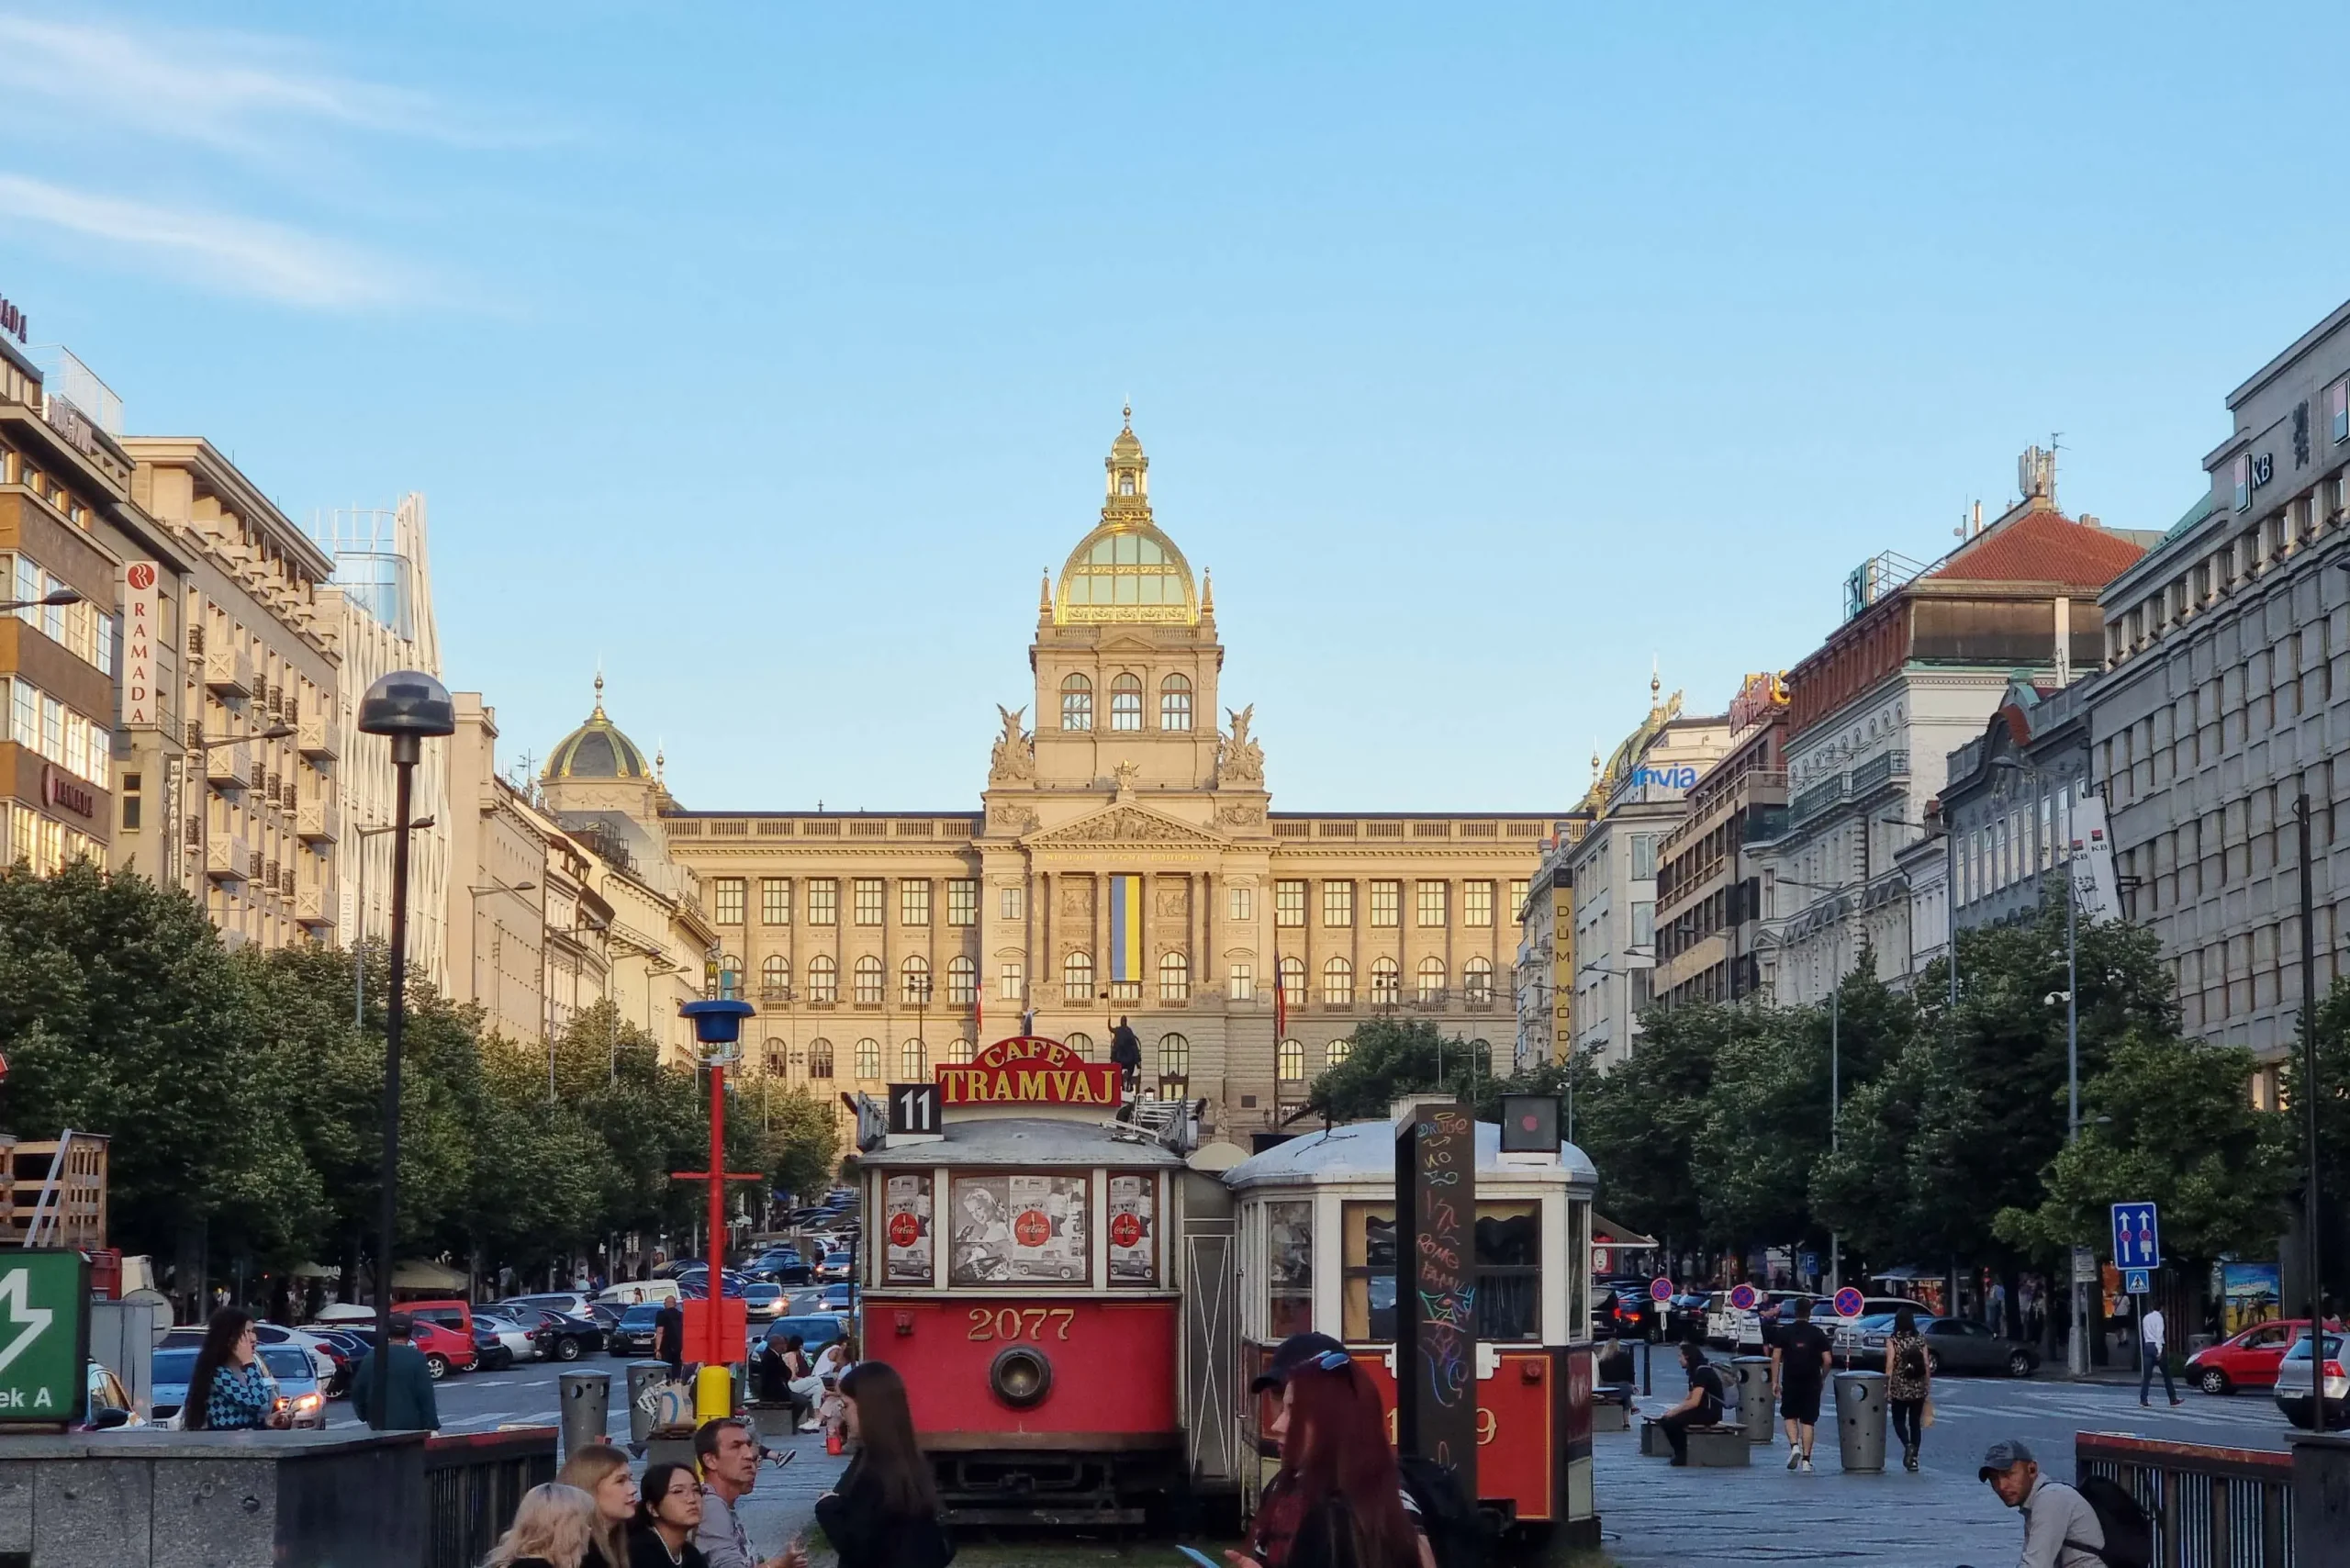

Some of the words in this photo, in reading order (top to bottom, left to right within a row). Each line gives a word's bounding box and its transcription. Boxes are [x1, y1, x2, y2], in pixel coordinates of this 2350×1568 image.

[0, 293, 28, 343] ADA
[2252, 454, 2272, 489] KB
[130, 602, 147, 722] RAMADA
[1632, 763, 1696, 789] invia
[2091, 844, 2108, 852] KB
[1556, 905, 1571, 963] DŮM
[1556, 984, 1571, 1064] MÓDY
[984, 1038, 1070, 1069] CAFE
[939, 1070, 1116, 1103] TRAMVAJ
[901, 1089, 930, 1130] 11
[968, 1307, 1075, 1340] 2077
[33, 1386, 52, 1407] A
